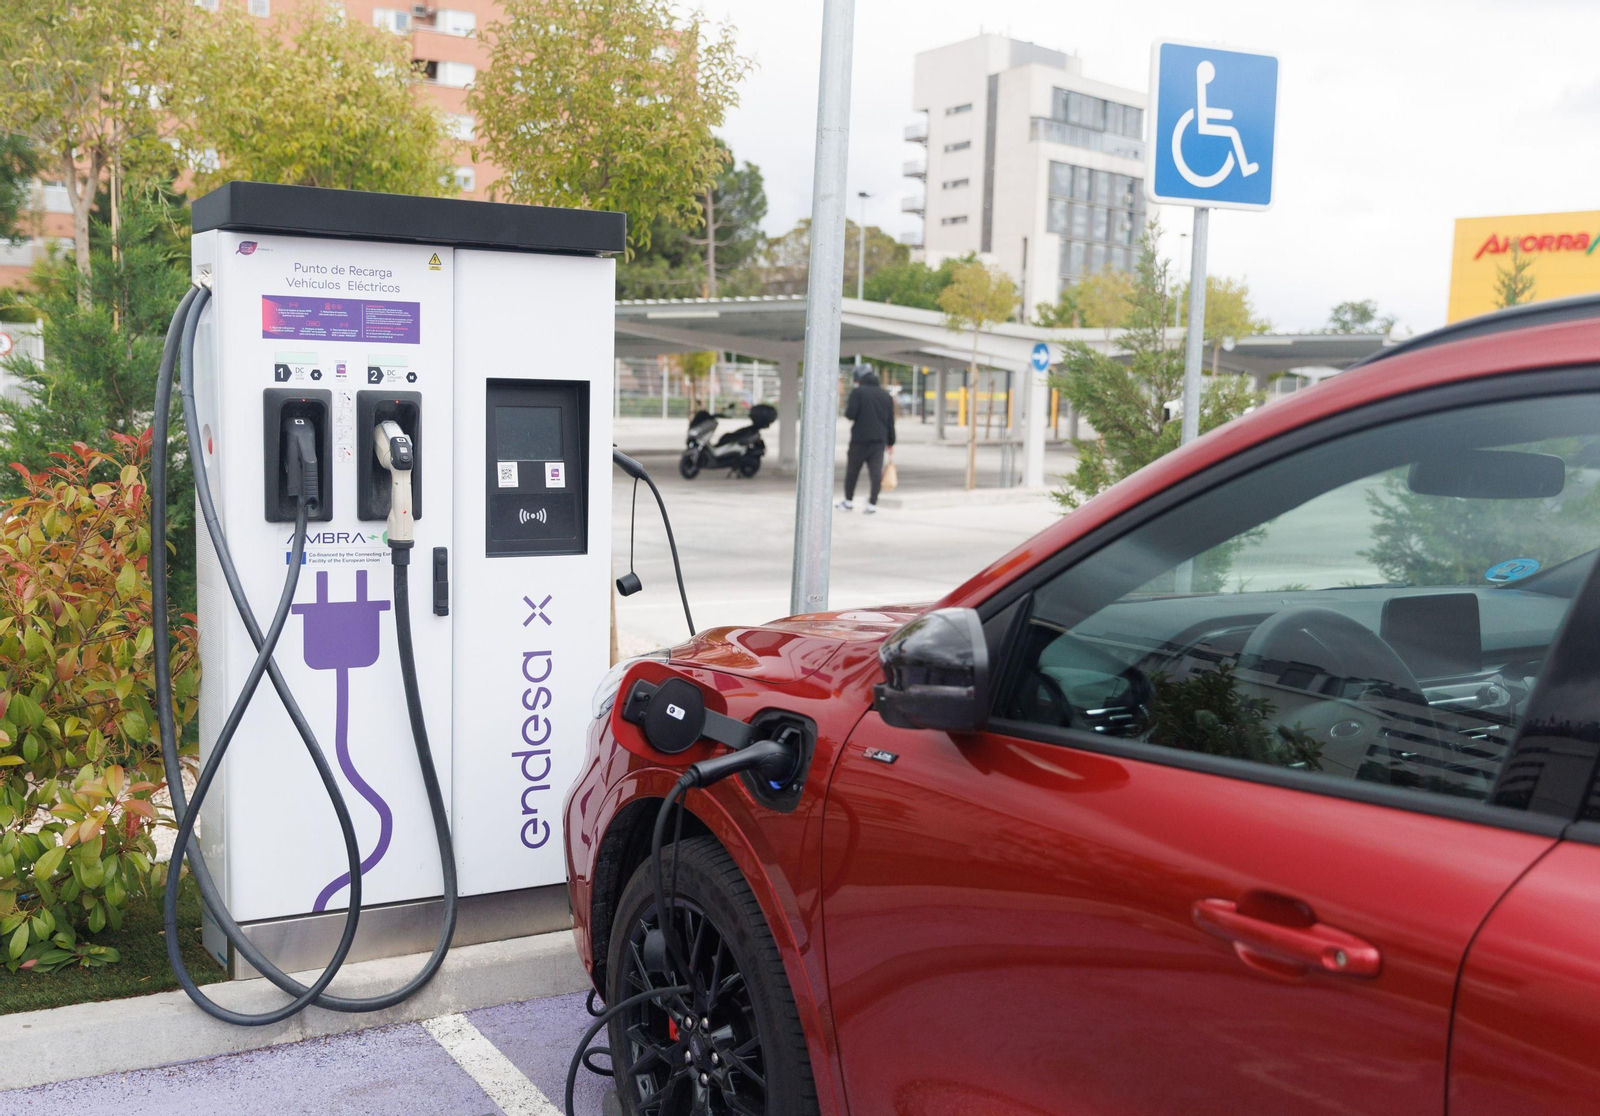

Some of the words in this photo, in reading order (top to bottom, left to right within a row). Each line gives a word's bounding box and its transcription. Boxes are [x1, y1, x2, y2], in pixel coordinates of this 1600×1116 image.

[294, 262, 328, 275] Punto
[330, 264, 346, 276] de
[349, 265, 393, 280] Recarga
[285, 277, 341, 290] Vehículos
[348, 280, 401, 294] Eléctricos
[278, 367, 284, 379] 1
[370, 370, 378, 381] 2
[511, 650, 553, 850] endesa
